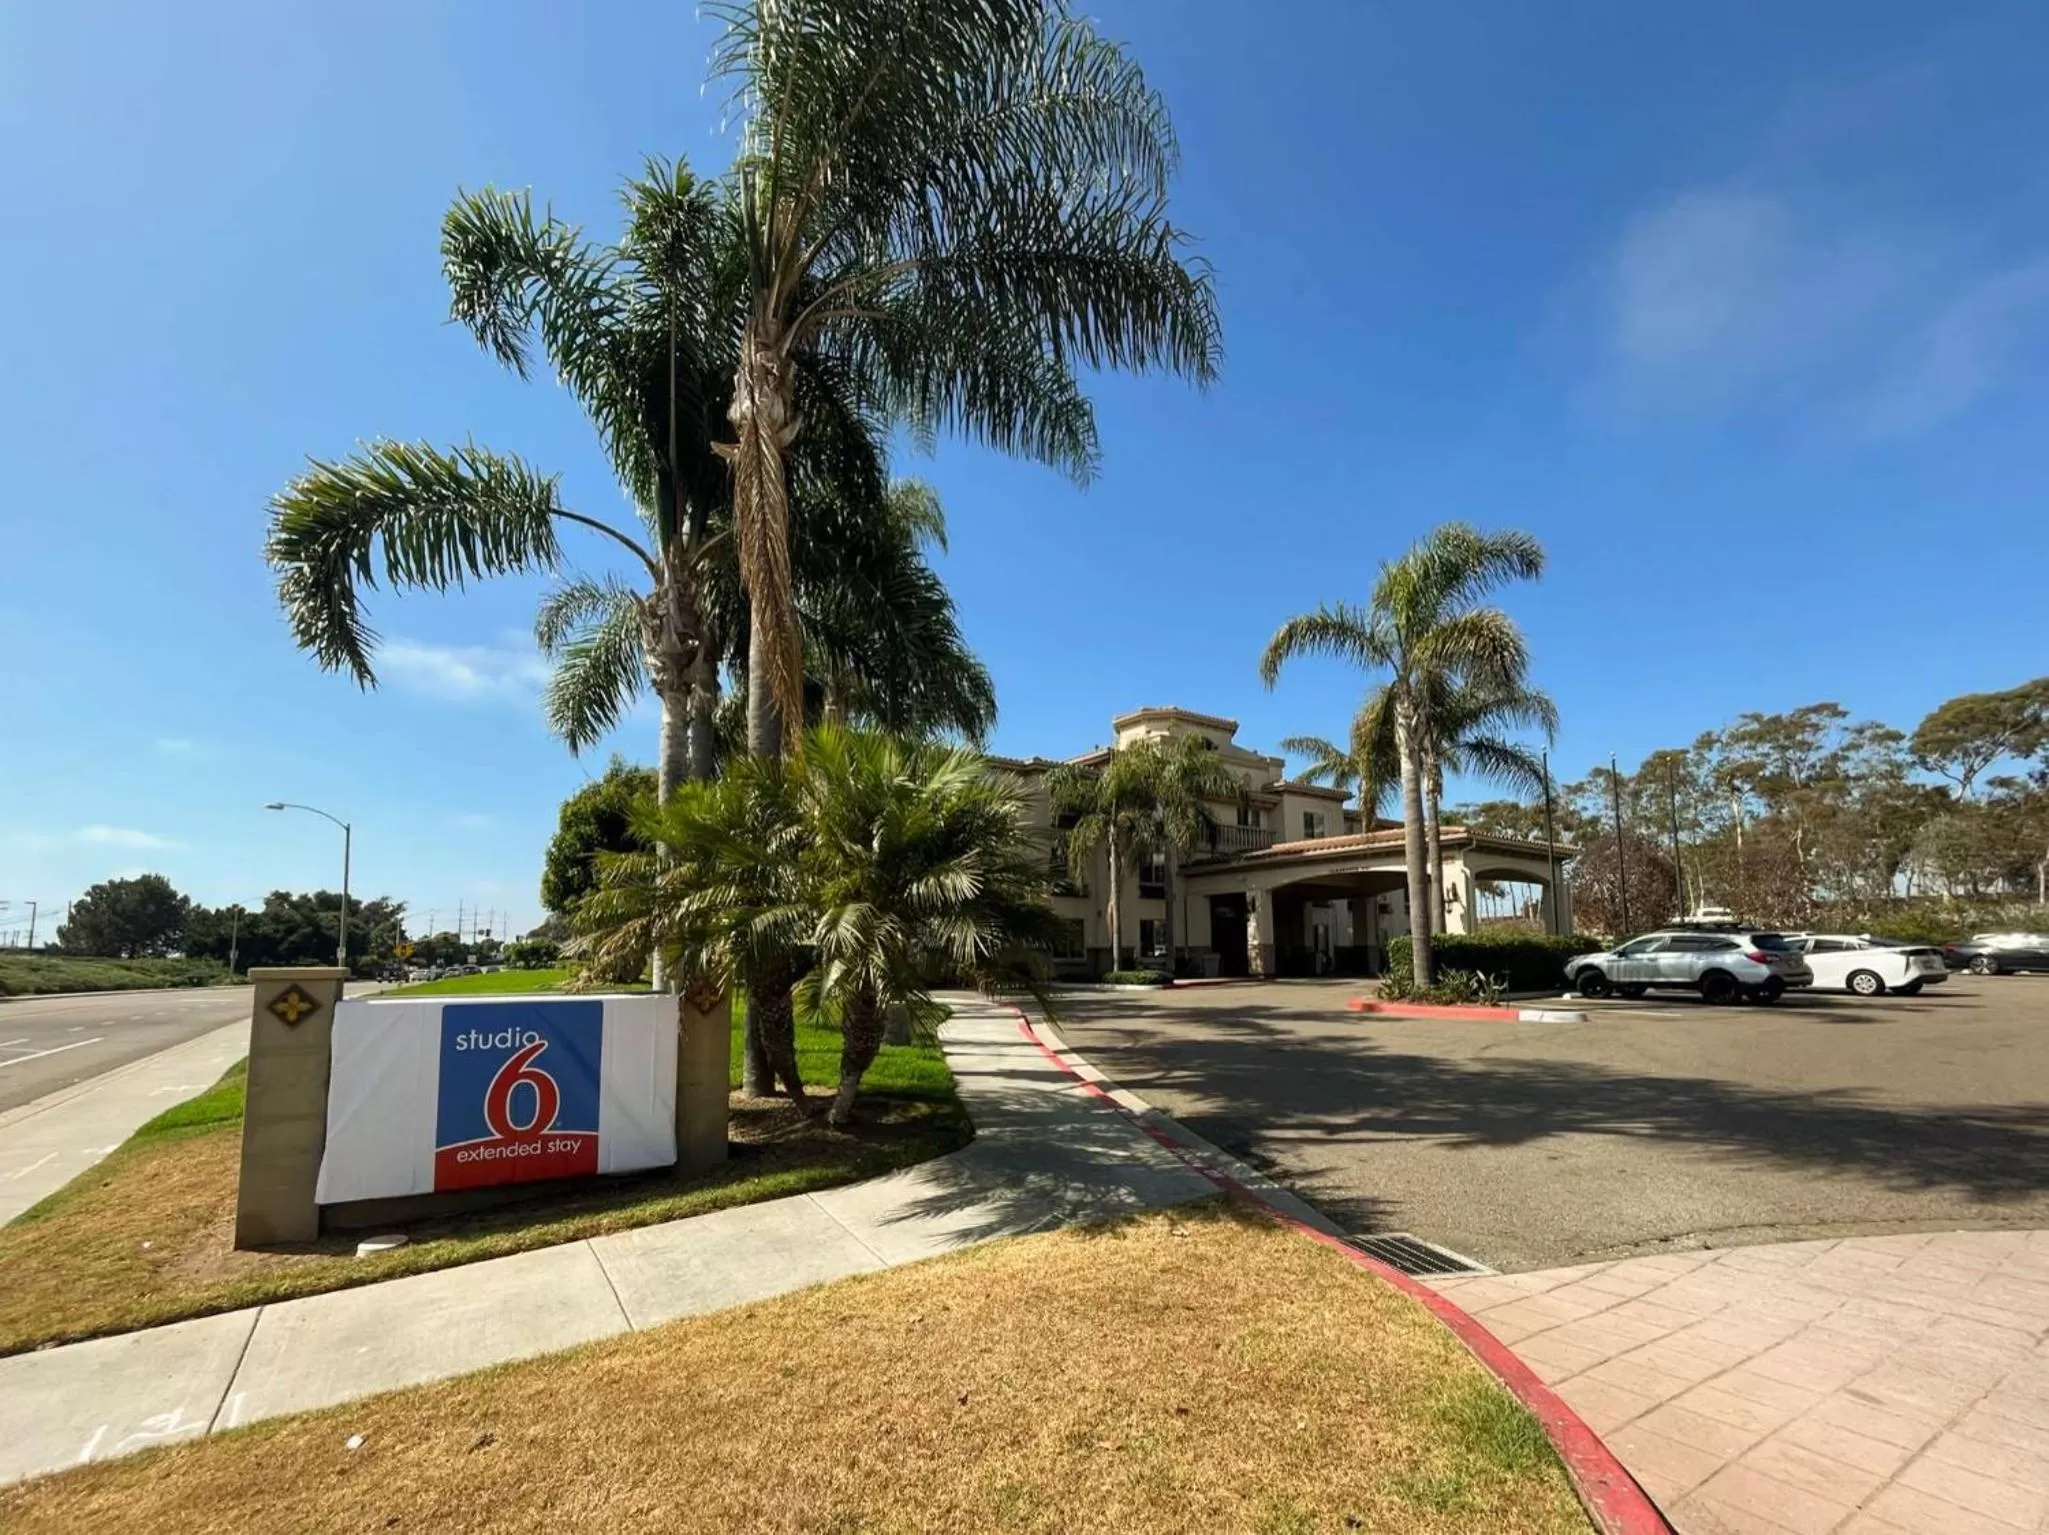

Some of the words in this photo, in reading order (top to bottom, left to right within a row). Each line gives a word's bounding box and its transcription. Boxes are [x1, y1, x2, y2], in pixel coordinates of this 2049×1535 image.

[456, 1027, 539, 1051] studio
[484, 1040, 560, 1138] 6
[456, 1140, 541, 1163] extended
[547, 1138, 582, 1155] stay
